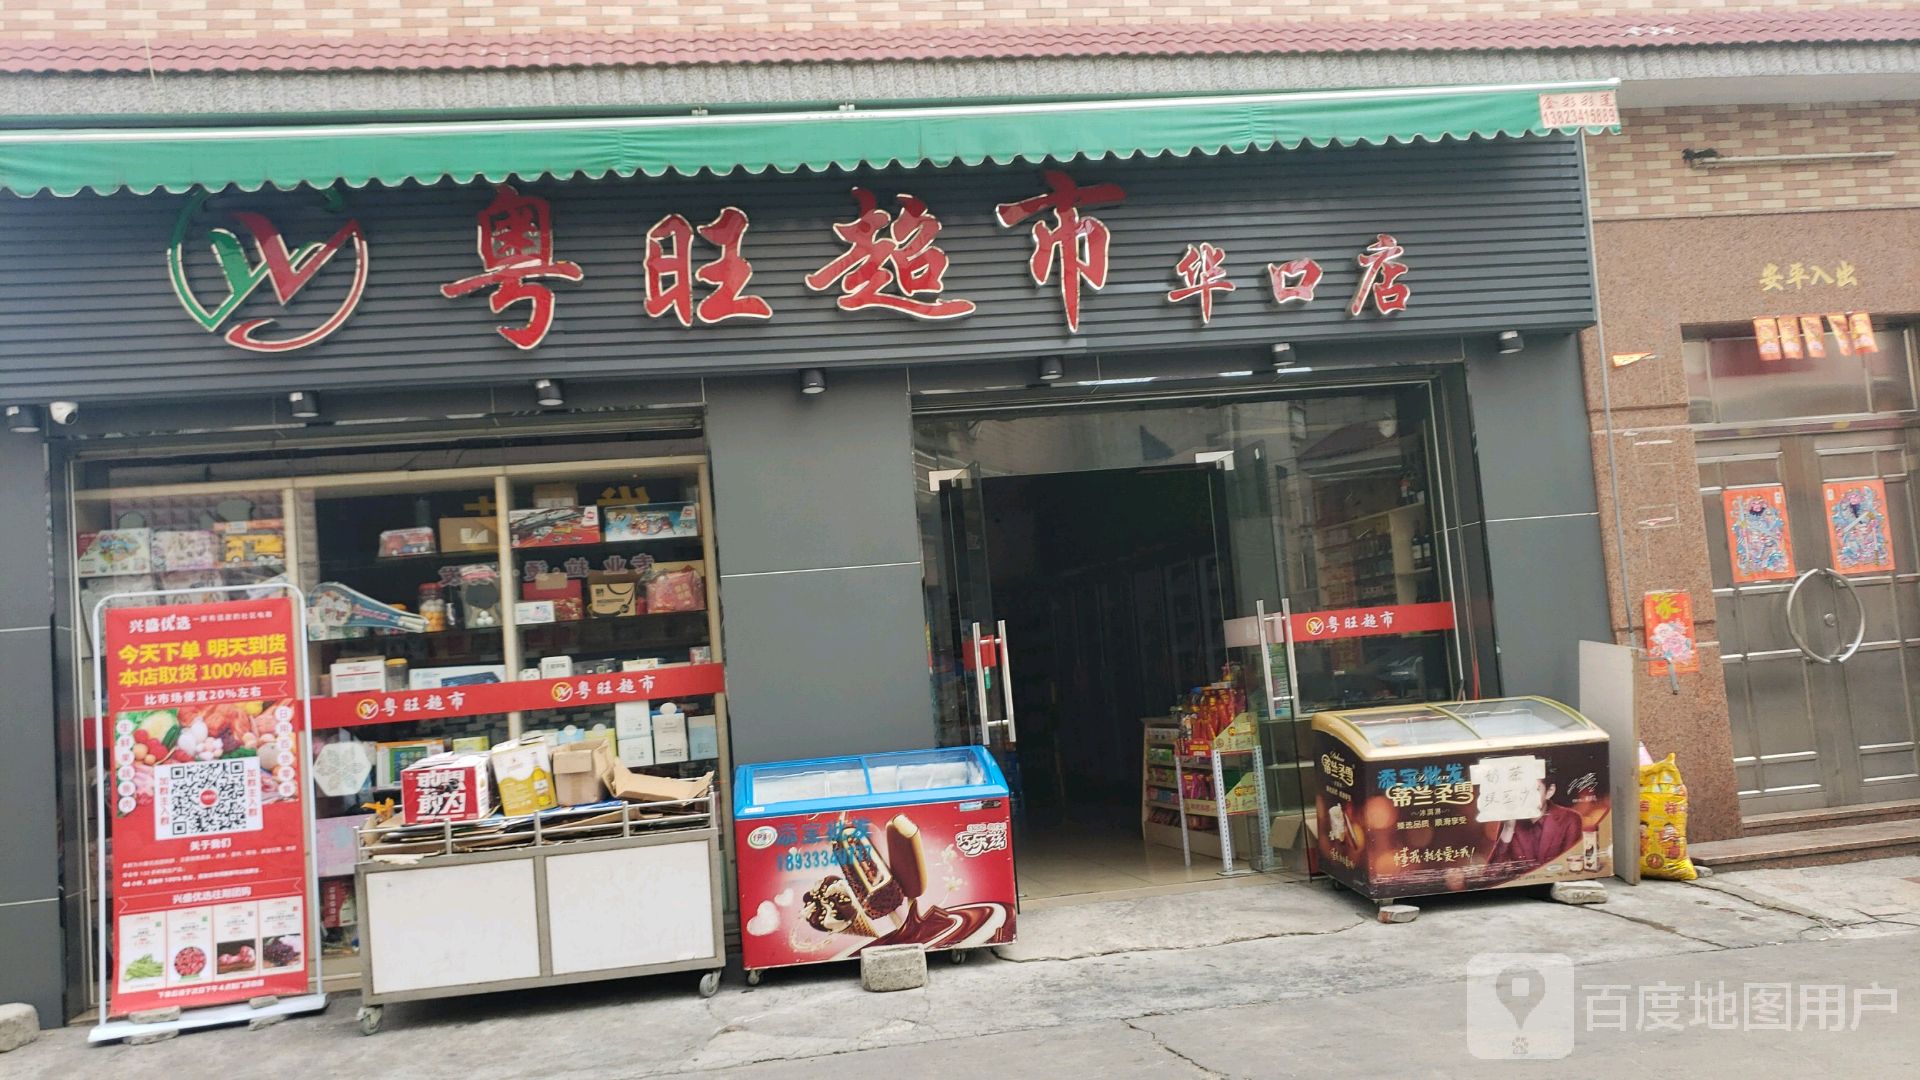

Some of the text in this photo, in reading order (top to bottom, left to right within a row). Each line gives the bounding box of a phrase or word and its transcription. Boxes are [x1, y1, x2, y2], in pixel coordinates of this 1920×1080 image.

[440, 170, 1411, 351] 粤旺超市 华口店
[129, 614, 192, 634] 兴盛优选
[1326, 610, 1395, 633] 粤旺超市
[118, 634, 287, 664] 今天下单 明天到货
[118, 657, 288, 687] 本店取货 100%售后
[144, 686, 262, 705] 比市场便宜20%左右
[575, 675, 656, 699] 粤旺超市
[381, 691, 466, 717] 粤旺超市
[1386, 782, 1473, 808] 蒂兰圣雪
[957, 831, 1006, 856] 巧乐兹
